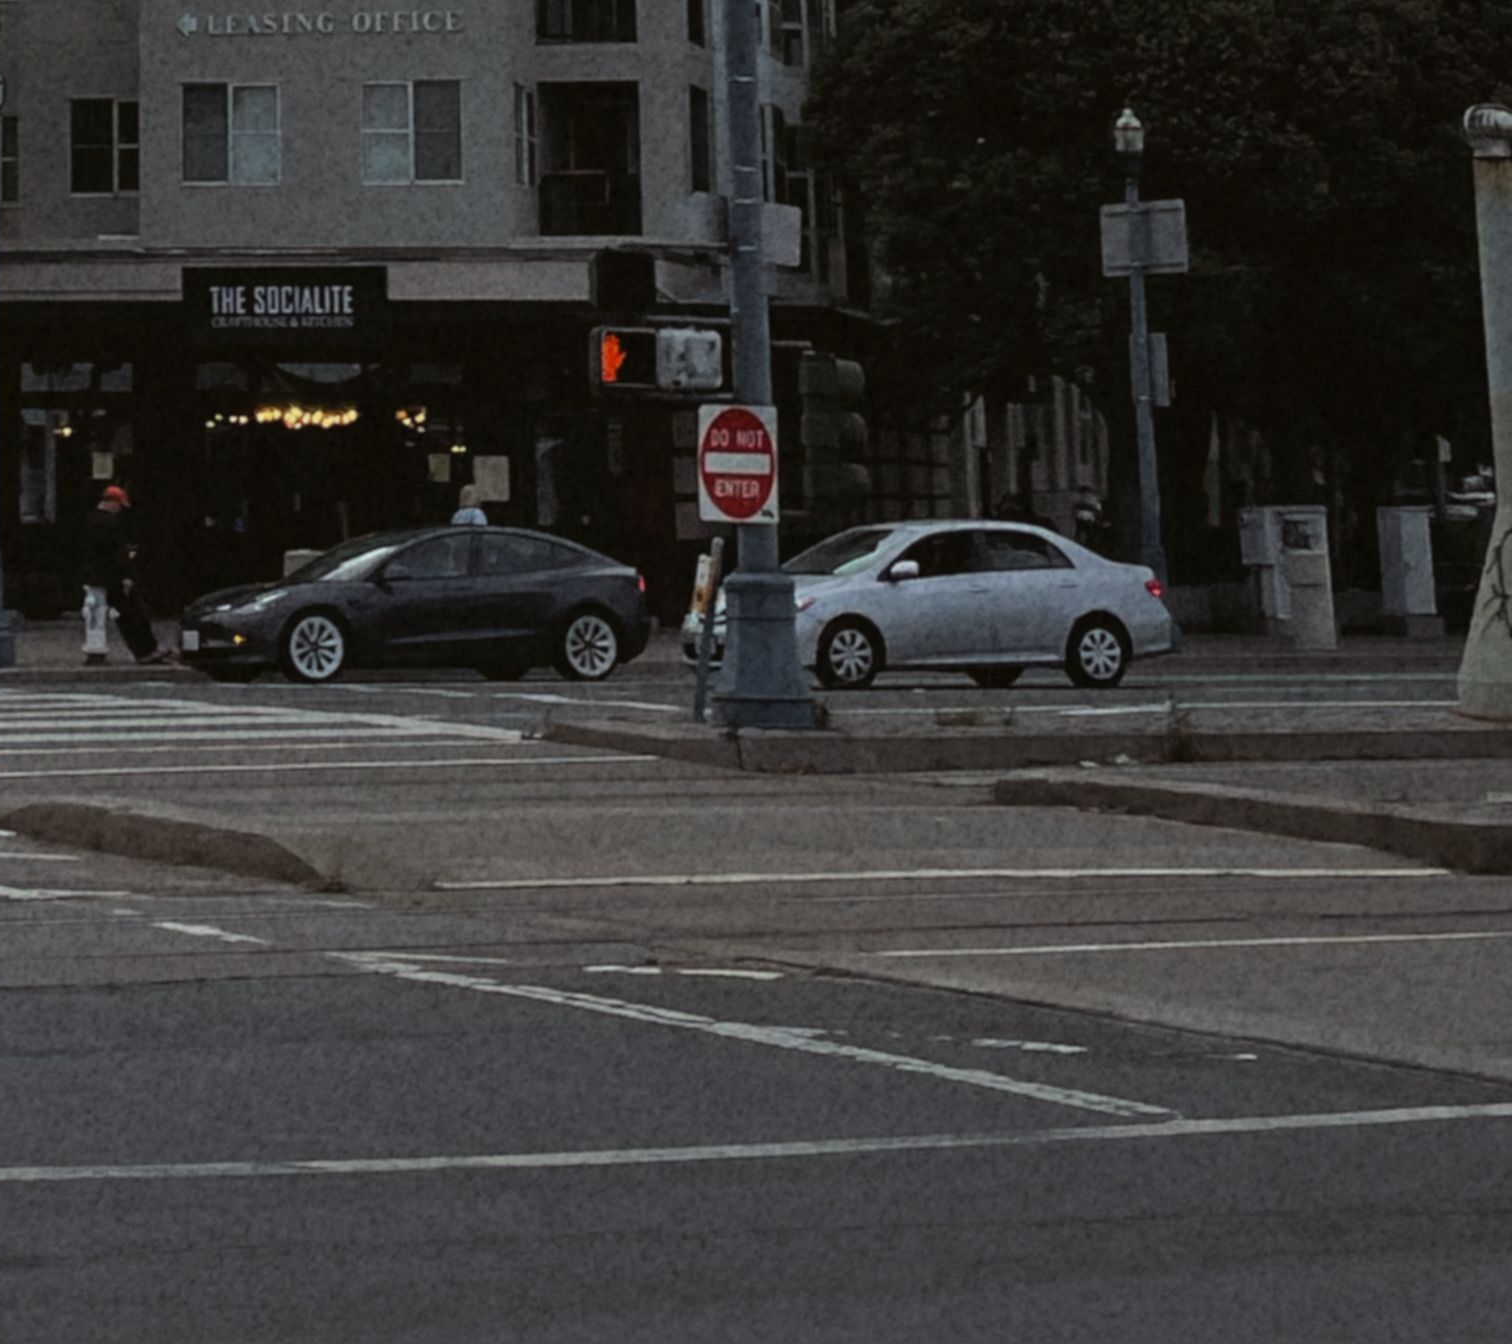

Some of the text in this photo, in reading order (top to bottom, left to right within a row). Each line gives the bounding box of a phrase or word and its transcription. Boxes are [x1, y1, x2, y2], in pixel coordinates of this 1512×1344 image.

[207, 10, 464, 35] LEASING OFFICE
[209, 285, 354, 315] THE SOCIALITE
[710, 428, 764, 449] DO NOT
[714, 478, 760, 499] ENTER
